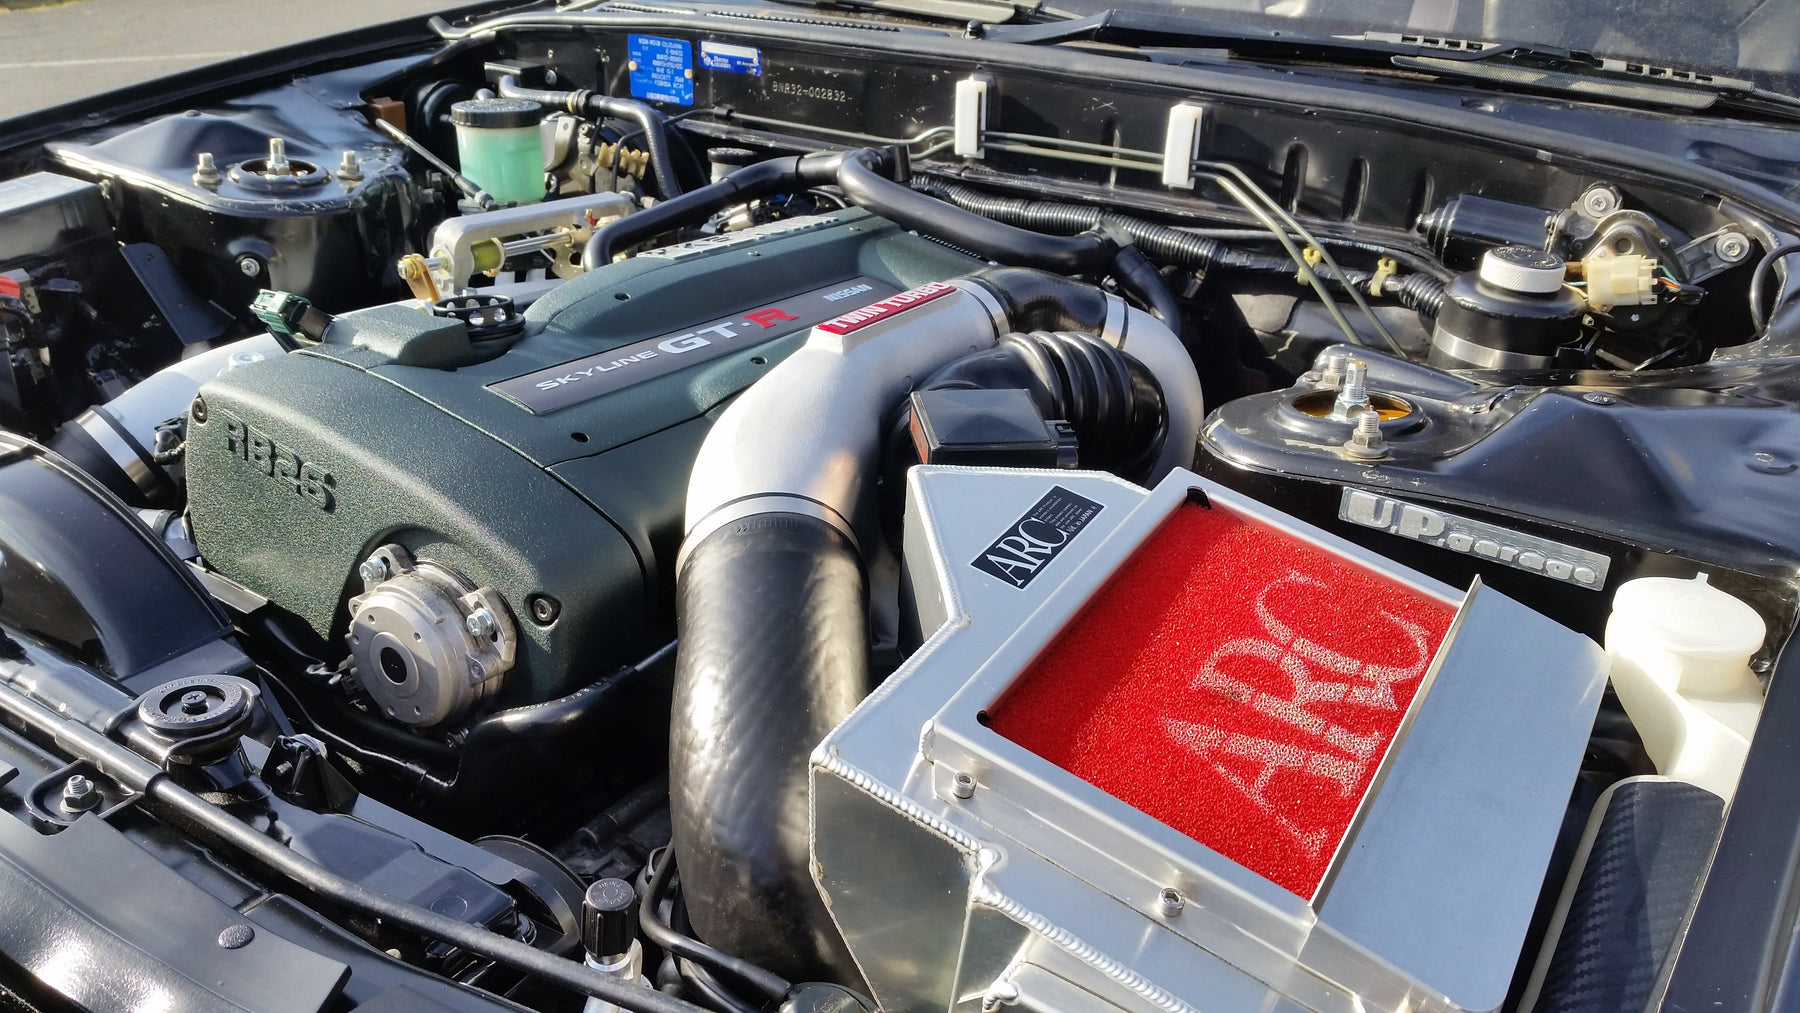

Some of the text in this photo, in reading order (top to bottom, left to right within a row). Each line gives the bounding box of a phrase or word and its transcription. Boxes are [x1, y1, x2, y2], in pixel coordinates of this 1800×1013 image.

[535, 350, 659, 391] SKYLINE
[822, 283, 874, 303] NISSAN
[824, 281, 952, 329] TWIN TURBO
[220, 408, 337, 515] RB26
[985, 516, 1070, 587] ARC
[1158, 568, 1431, 861] ARC
